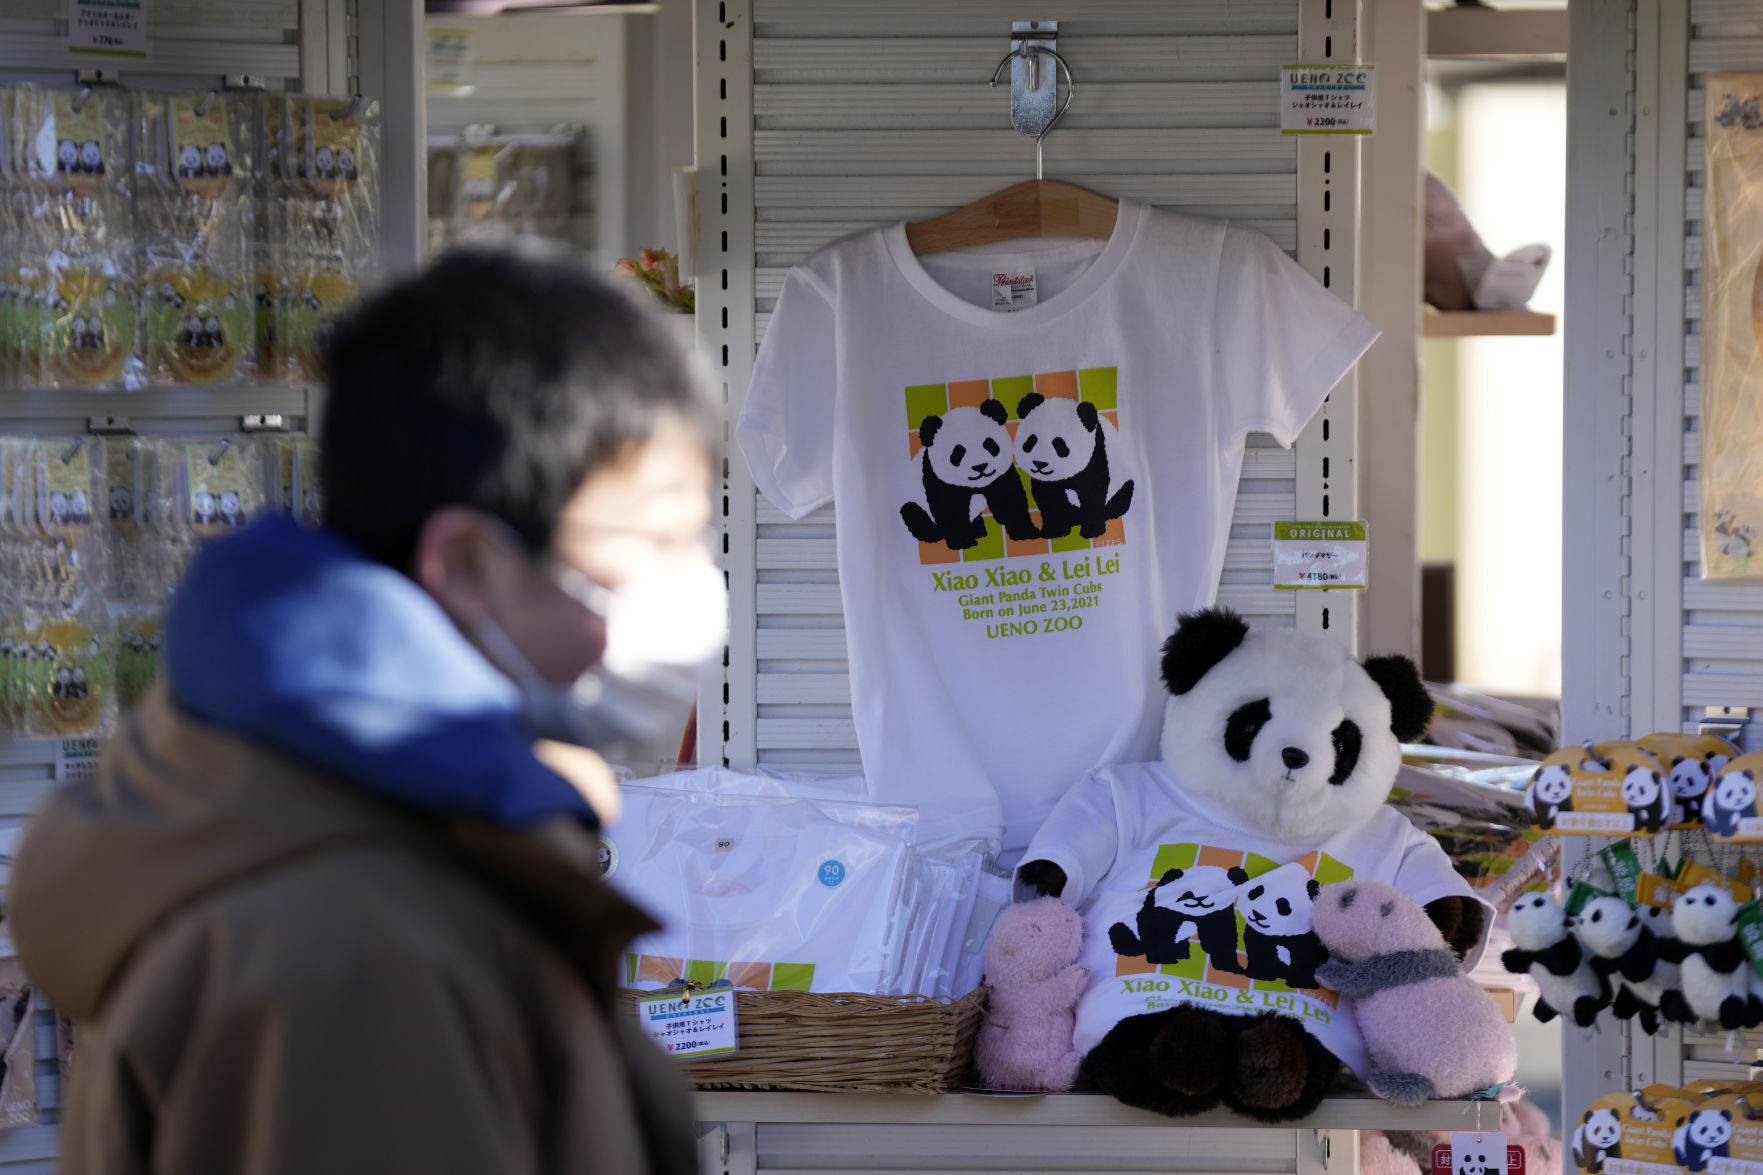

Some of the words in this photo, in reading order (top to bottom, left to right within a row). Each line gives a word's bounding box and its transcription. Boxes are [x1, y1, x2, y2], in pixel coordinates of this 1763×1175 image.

[1290, 72, 1331, 84] UENO
[1290, 528, 1350, 538] ORIGINAL
[931, 569, 979, 592] Xiao
[984, 566, 1032, 588] Xiao
[1038, 561, 1056, 582] &
[1062, 556, 1091, 580] Lei
[1096, 552, 1120, 576] Lei
[958, 594, 994, 607] Giant
[998, 588, 1036, 604] Panda
[1039, 584, 1070, 599] Twin
[1073, 581, 1103, 595] Cubs
[963, 608, 994, 620] Born
[998, 607, 1014, 616] on
[1018, 602, 1047, 616] June
[1051, 595, 1100, 613] 23,2021
[986, 619, 1038, 639] UENO
[1043, 615, 1083, 633] ZOO
[824, 865, 839, 876] 90
[695, 995, 726, 1009] ZOO
[1120, 978, 1170, 994] Xiao
[1177, 979, 1228, 1002] Xiao
[1235, 988, 1255, 1004] &
[1263, 992, 1295, 1011] Lei
[1303, 1001, 1330, 1025] Lei
